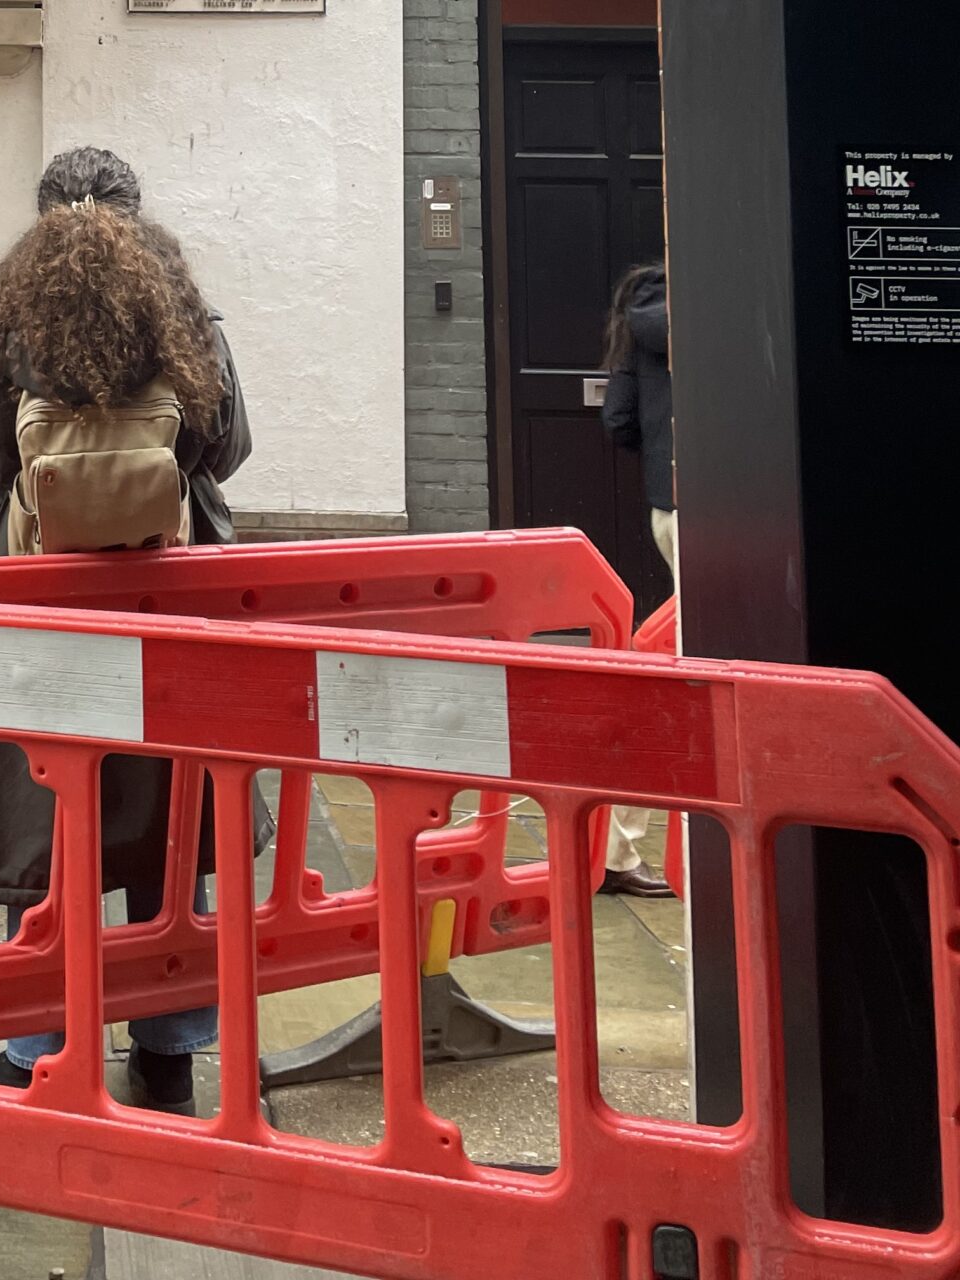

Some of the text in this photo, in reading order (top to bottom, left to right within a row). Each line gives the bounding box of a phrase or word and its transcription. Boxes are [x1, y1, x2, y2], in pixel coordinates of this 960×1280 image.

[865, 152, 898, 160] property
[944, 153, 954, 161] by
[875, 188, 910, 198] Company
[887, 244, 924, 252] including
